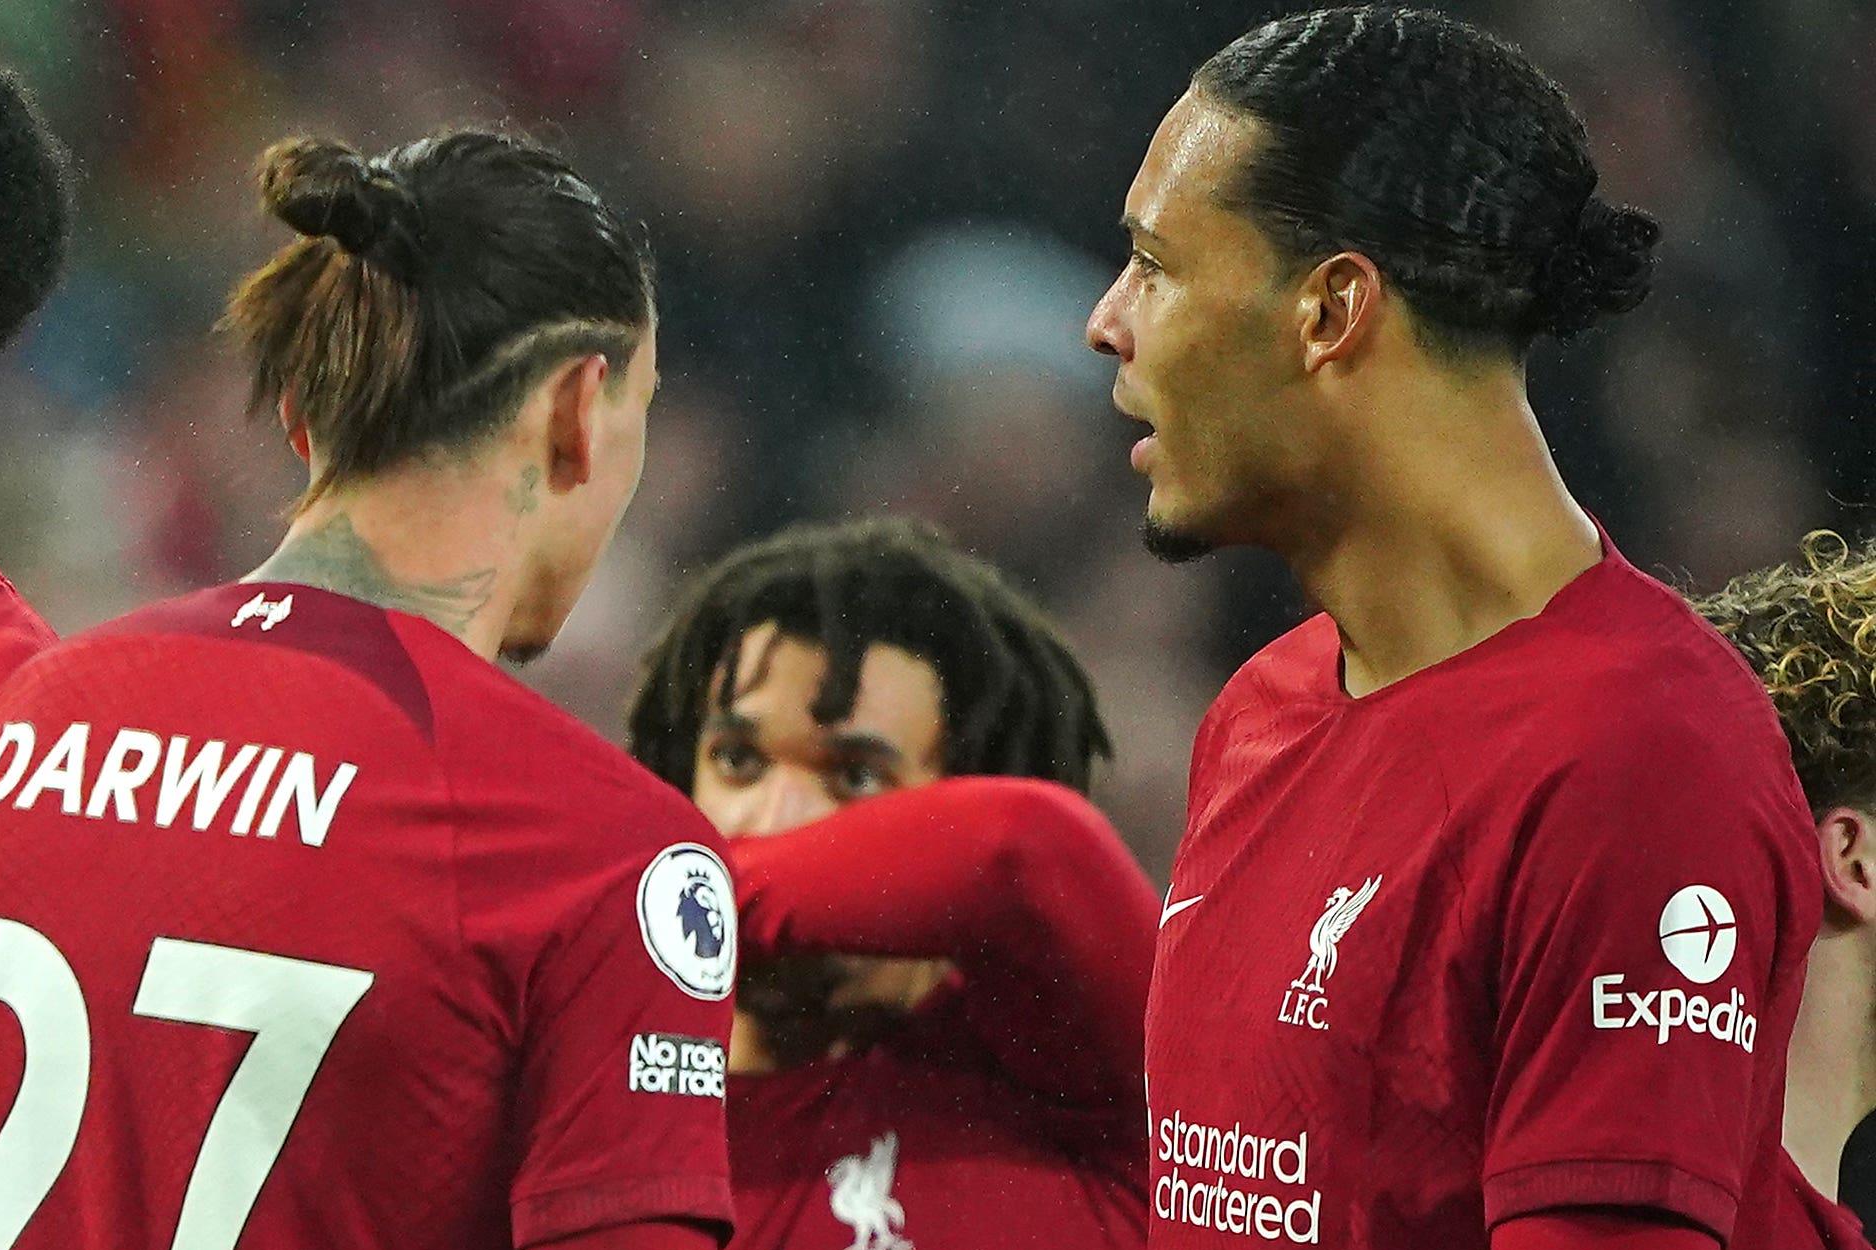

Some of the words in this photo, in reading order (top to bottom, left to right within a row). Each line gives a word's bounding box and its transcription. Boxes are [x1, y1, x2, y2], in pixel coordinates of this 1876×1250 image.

[631, 1034, 677, 1067] No
[1592, 974, 1757, 1053] Expedia
[1158, 1110, 1307, 1184] standard
[1155, 1167, 1321, 1243] chartered
